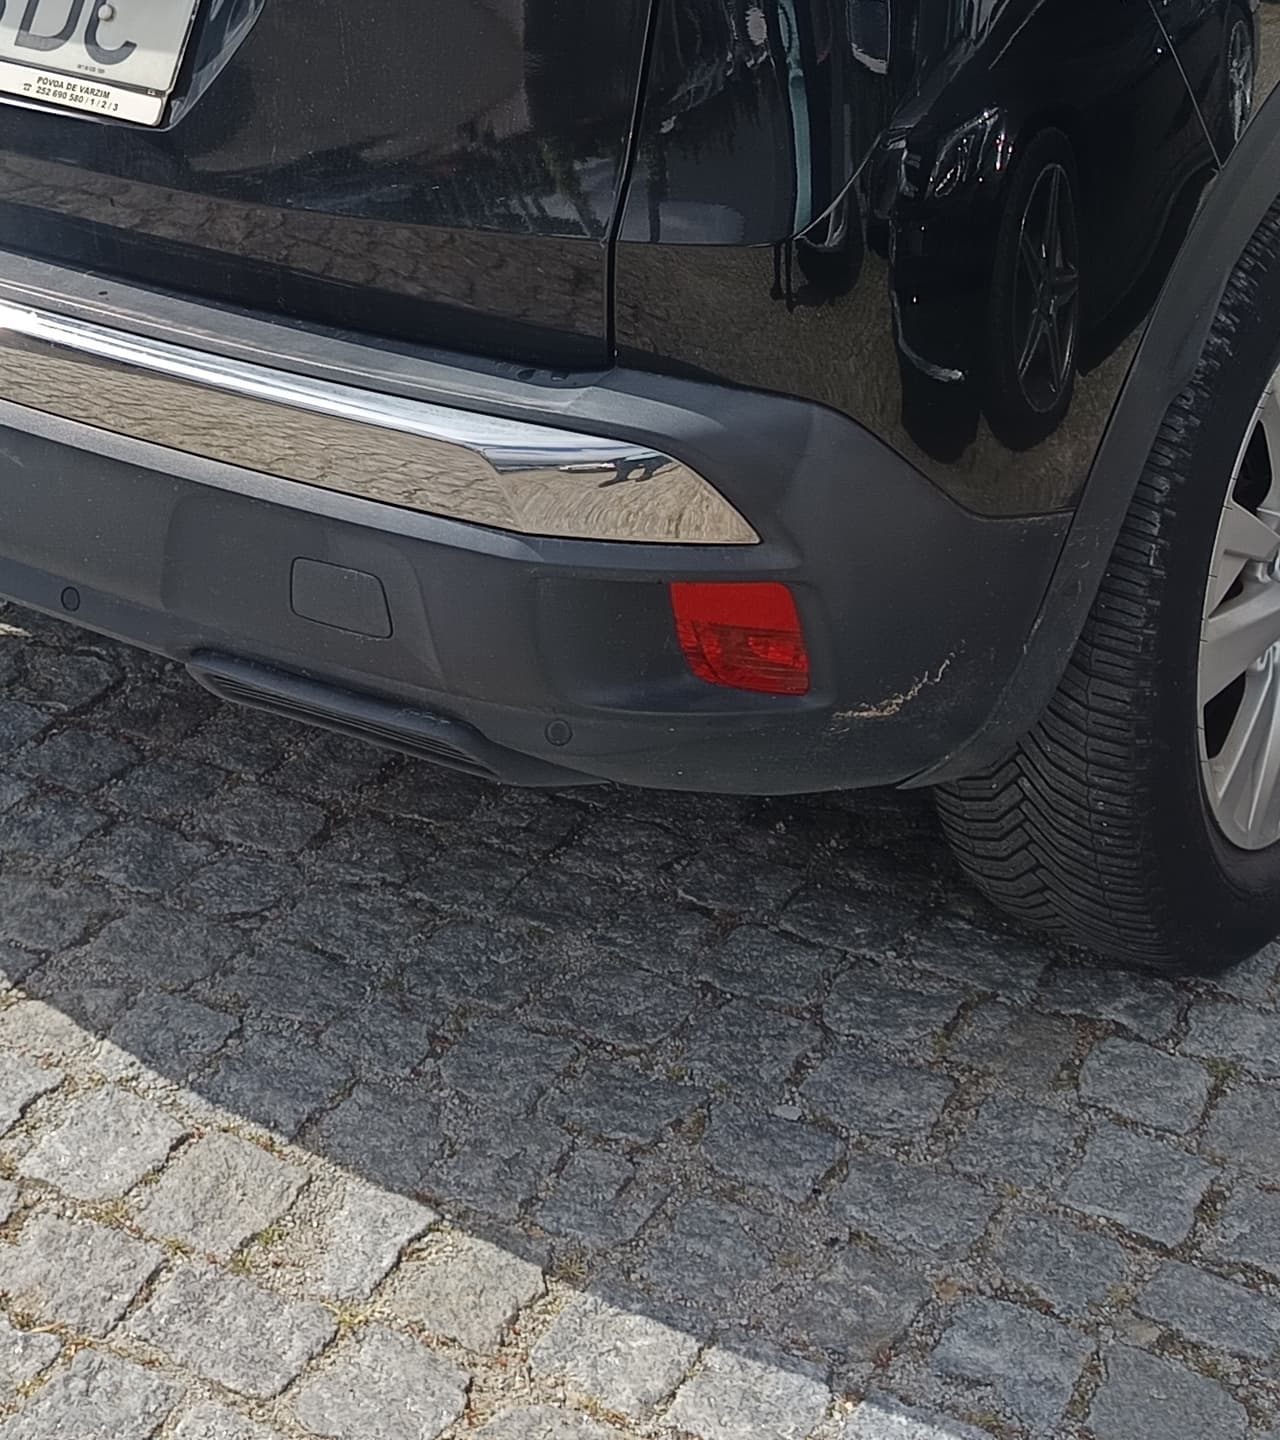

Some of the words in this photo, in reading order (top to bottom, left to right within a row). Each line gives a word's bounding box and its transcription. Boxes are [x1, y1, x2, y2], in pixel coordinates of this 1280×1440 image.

[36, 86, 51, 96] 252
[52, 90, 67, 100] 690
[66, 82, 78, 92] DE
[79, 85, 111, 99] VARZIM
